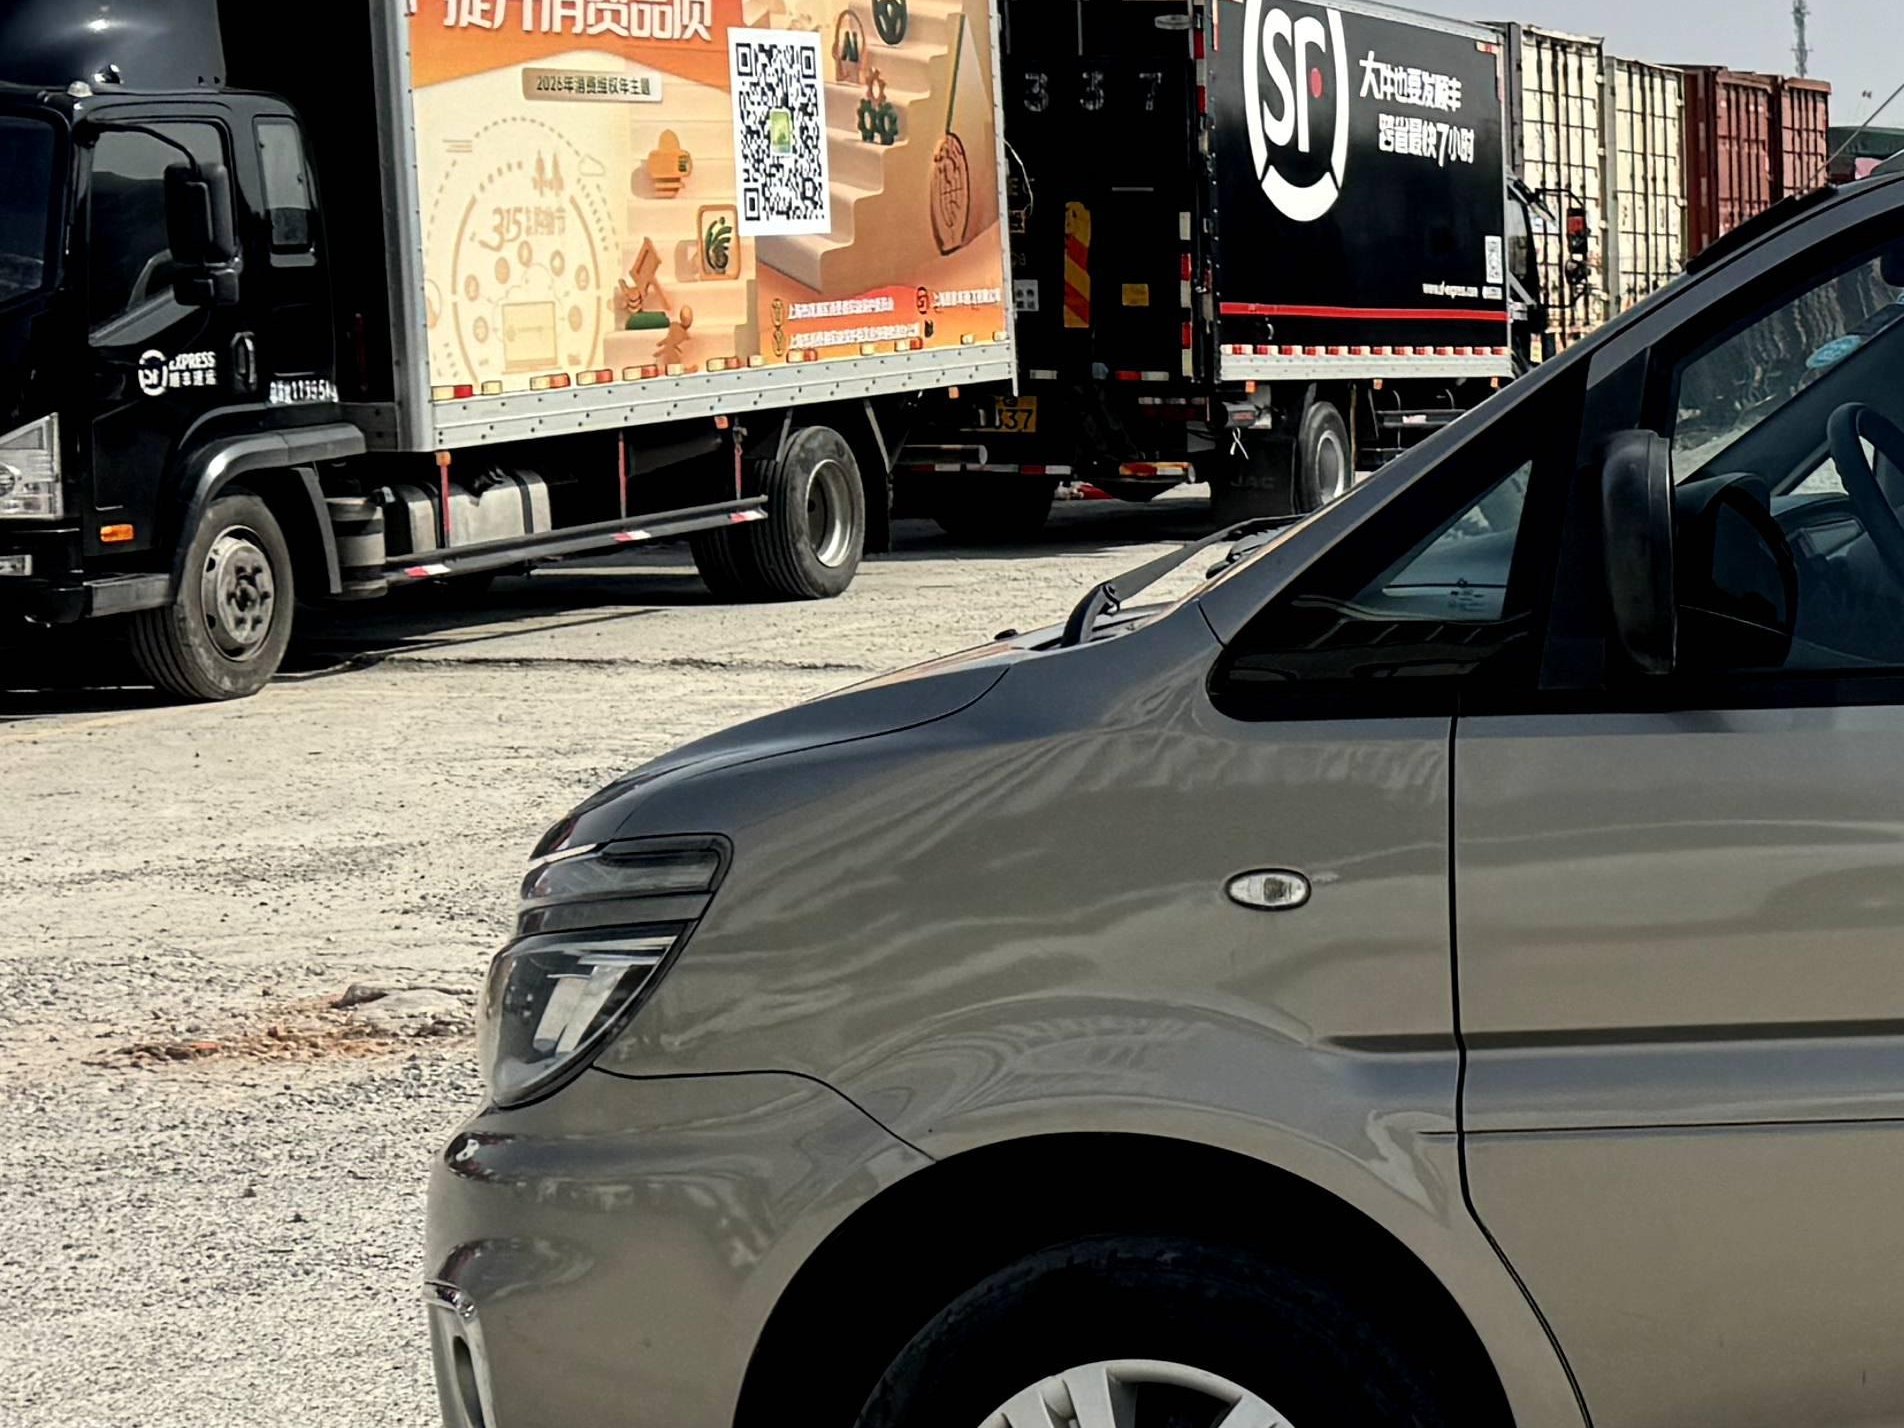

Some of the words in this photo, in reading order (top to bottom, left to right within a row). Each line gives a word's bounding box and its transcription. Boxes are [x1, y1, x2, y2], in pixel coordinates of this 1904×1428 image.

[1359, 50, 1463, 112] 大件也要发顺丰
